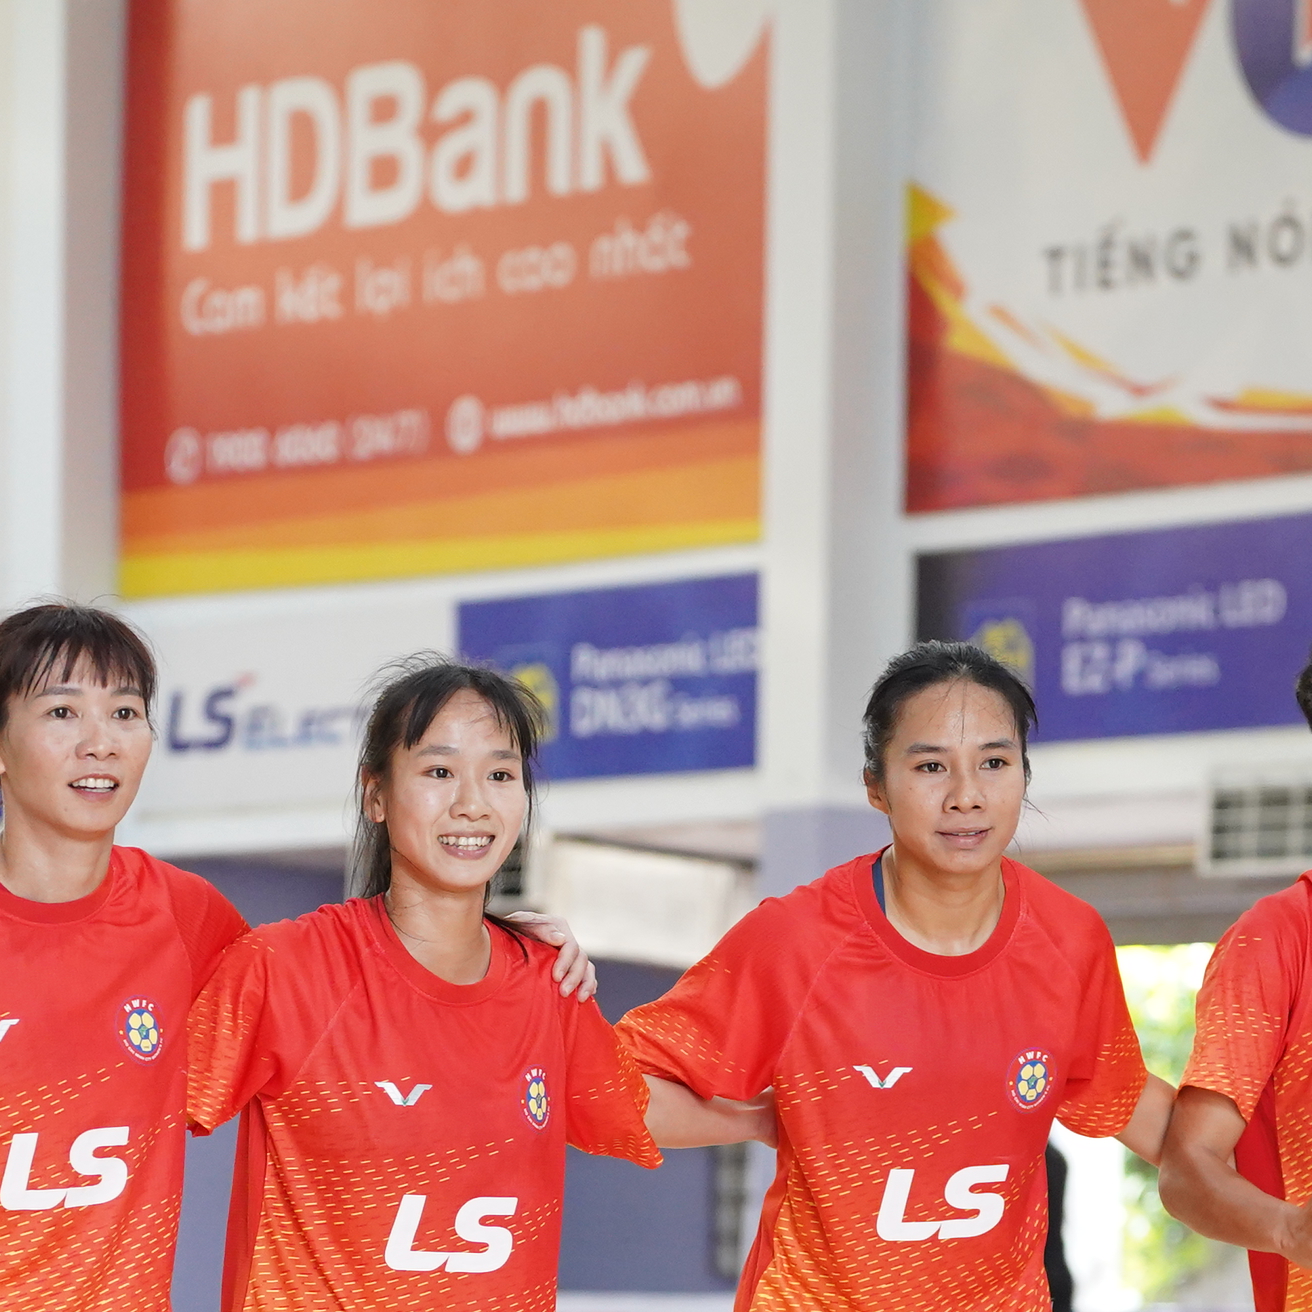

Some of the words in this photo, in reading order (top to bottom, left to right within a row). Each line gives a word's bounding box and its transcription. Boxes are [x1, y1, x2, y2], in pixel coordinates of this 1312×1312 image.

[182, 22, 652, 251] HDBank
[1041, 214, 1203, 296] TIẾNG
[167, 683, 235, 753] LS
[384, 1194, 519, 1274] LS
[876, 1163, 1011, 1242] LS
